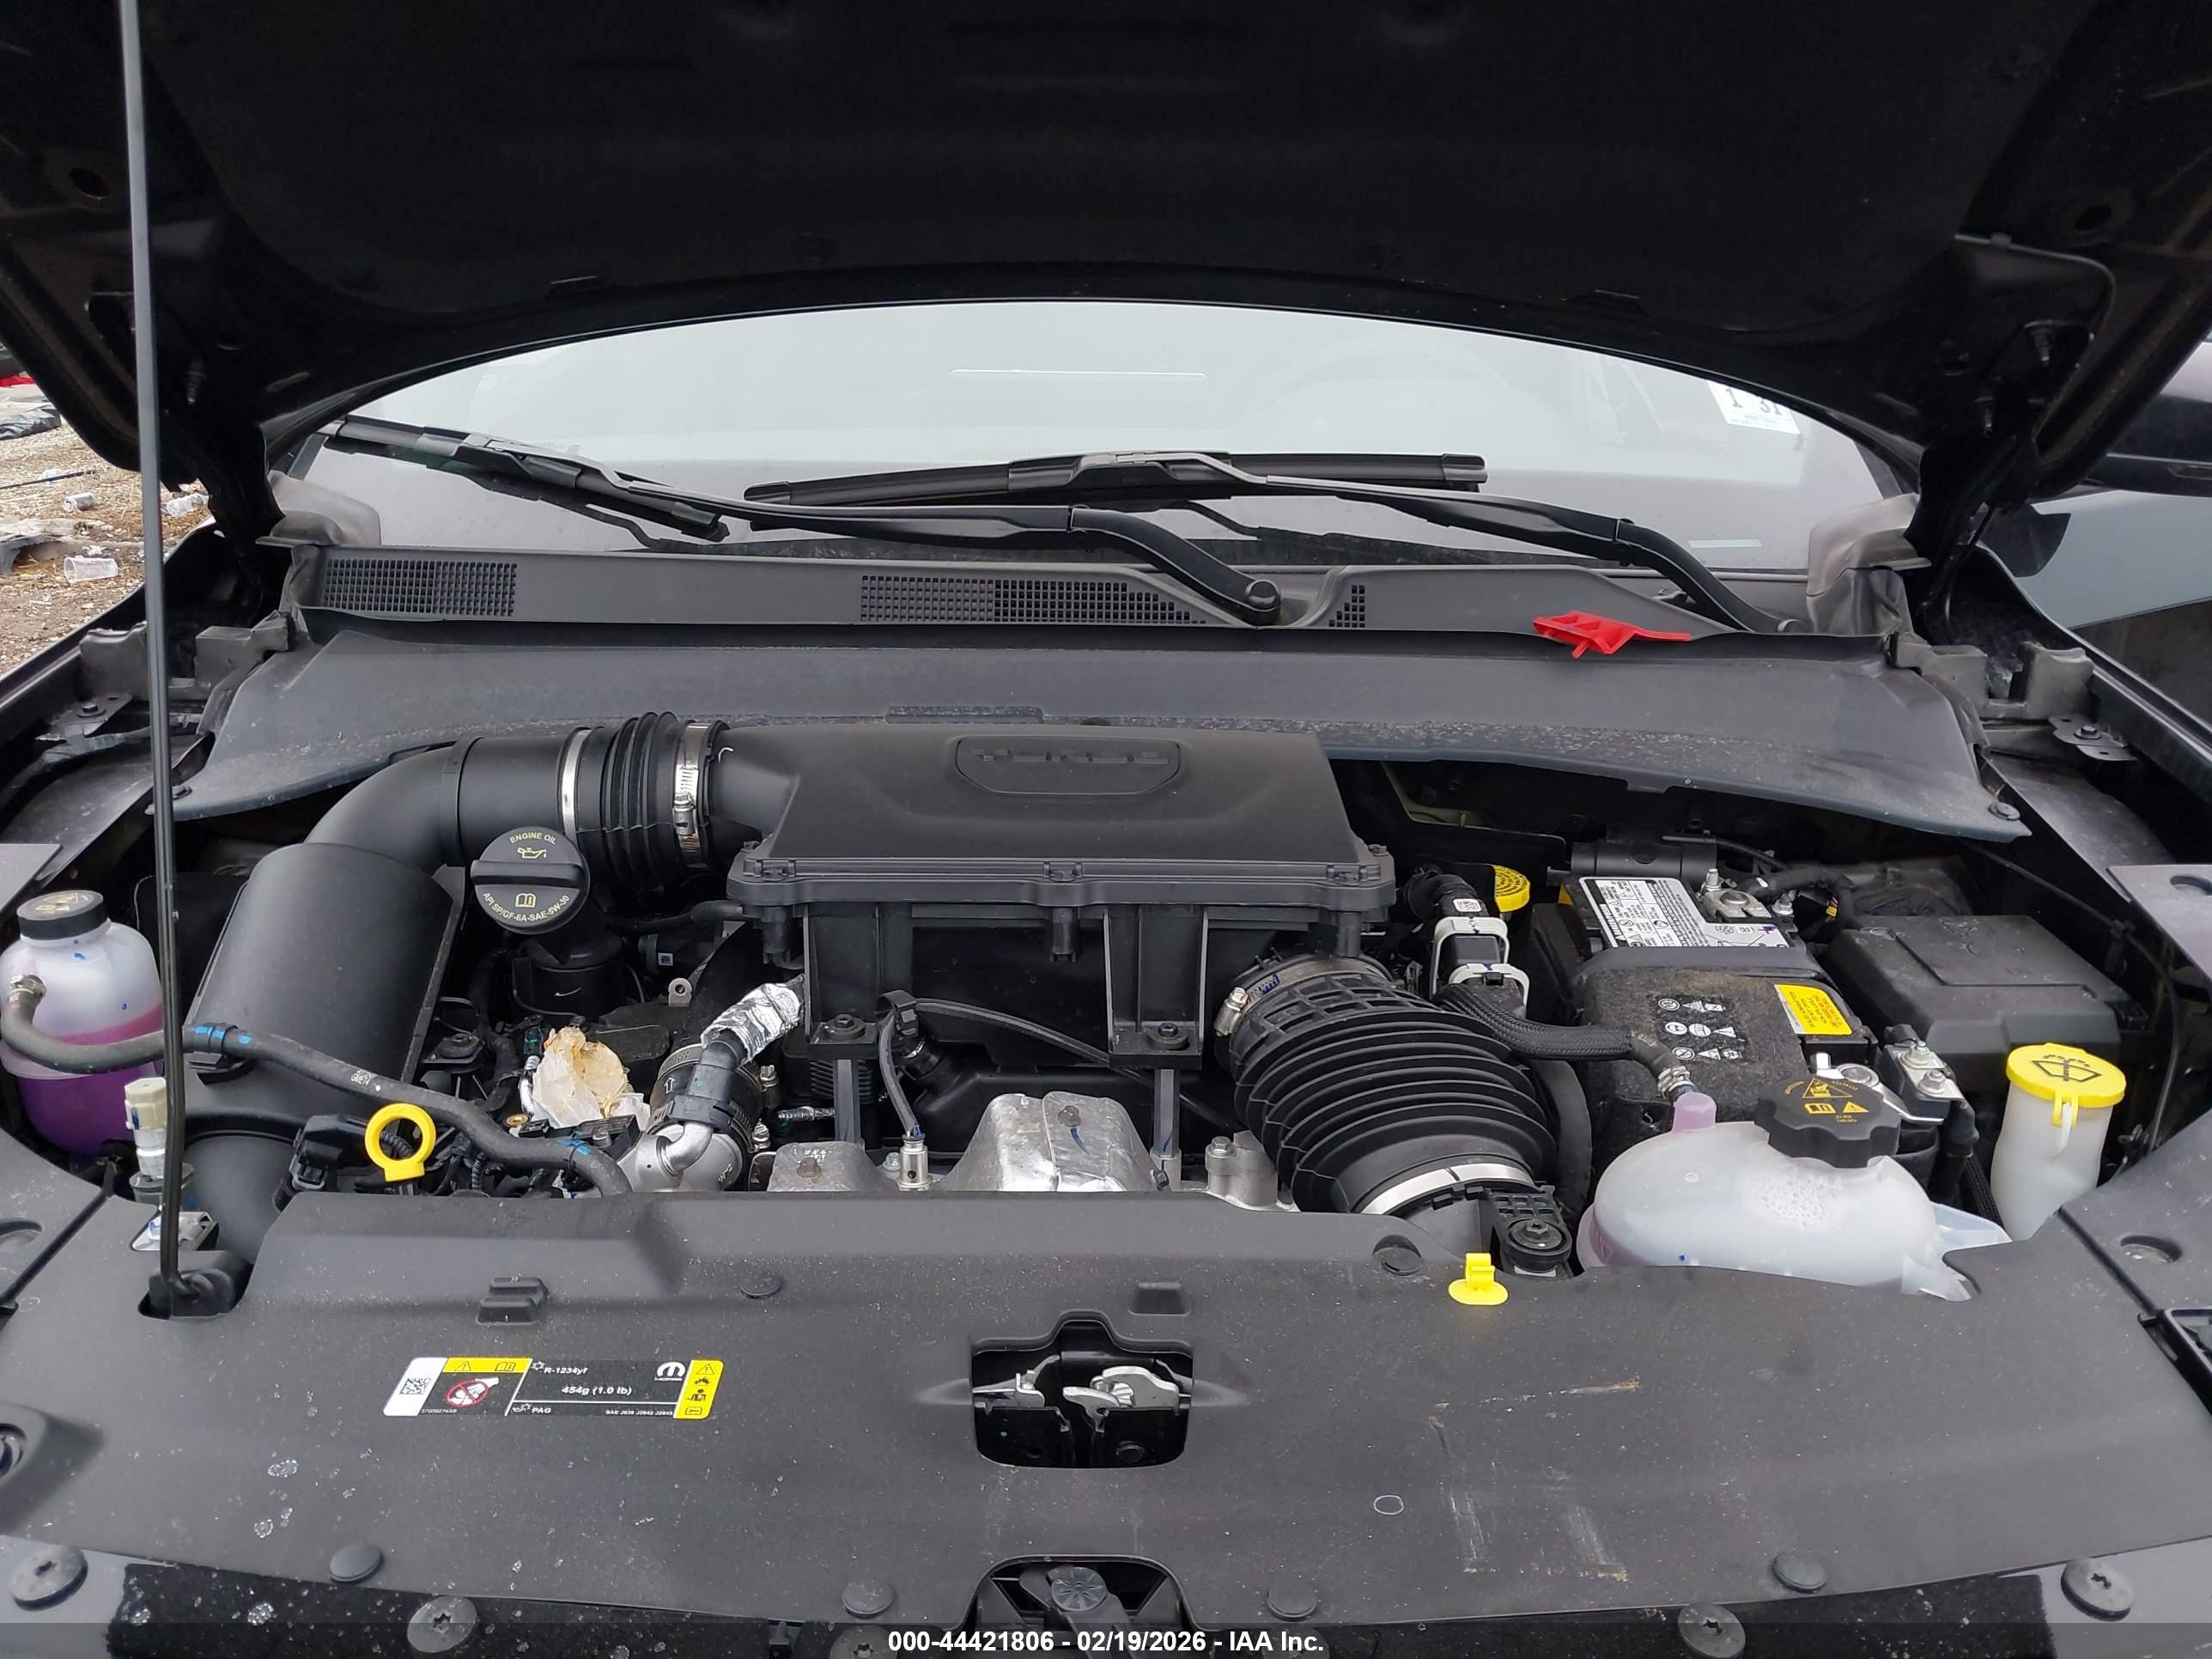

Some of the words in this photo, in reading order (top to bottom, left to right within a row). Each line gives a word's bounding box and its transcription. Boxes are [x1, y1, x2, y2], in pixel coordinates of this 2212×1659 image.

[509, 832, 543, 844] ENGINE
[544, 834, 556, 845] OIL
[483, 892, 494, 908] API
[561, 1387, 590, 1396] 454g
[592, 1386, 614, 1396] (1.0
[617, 1386, 632, 1396] lb)
